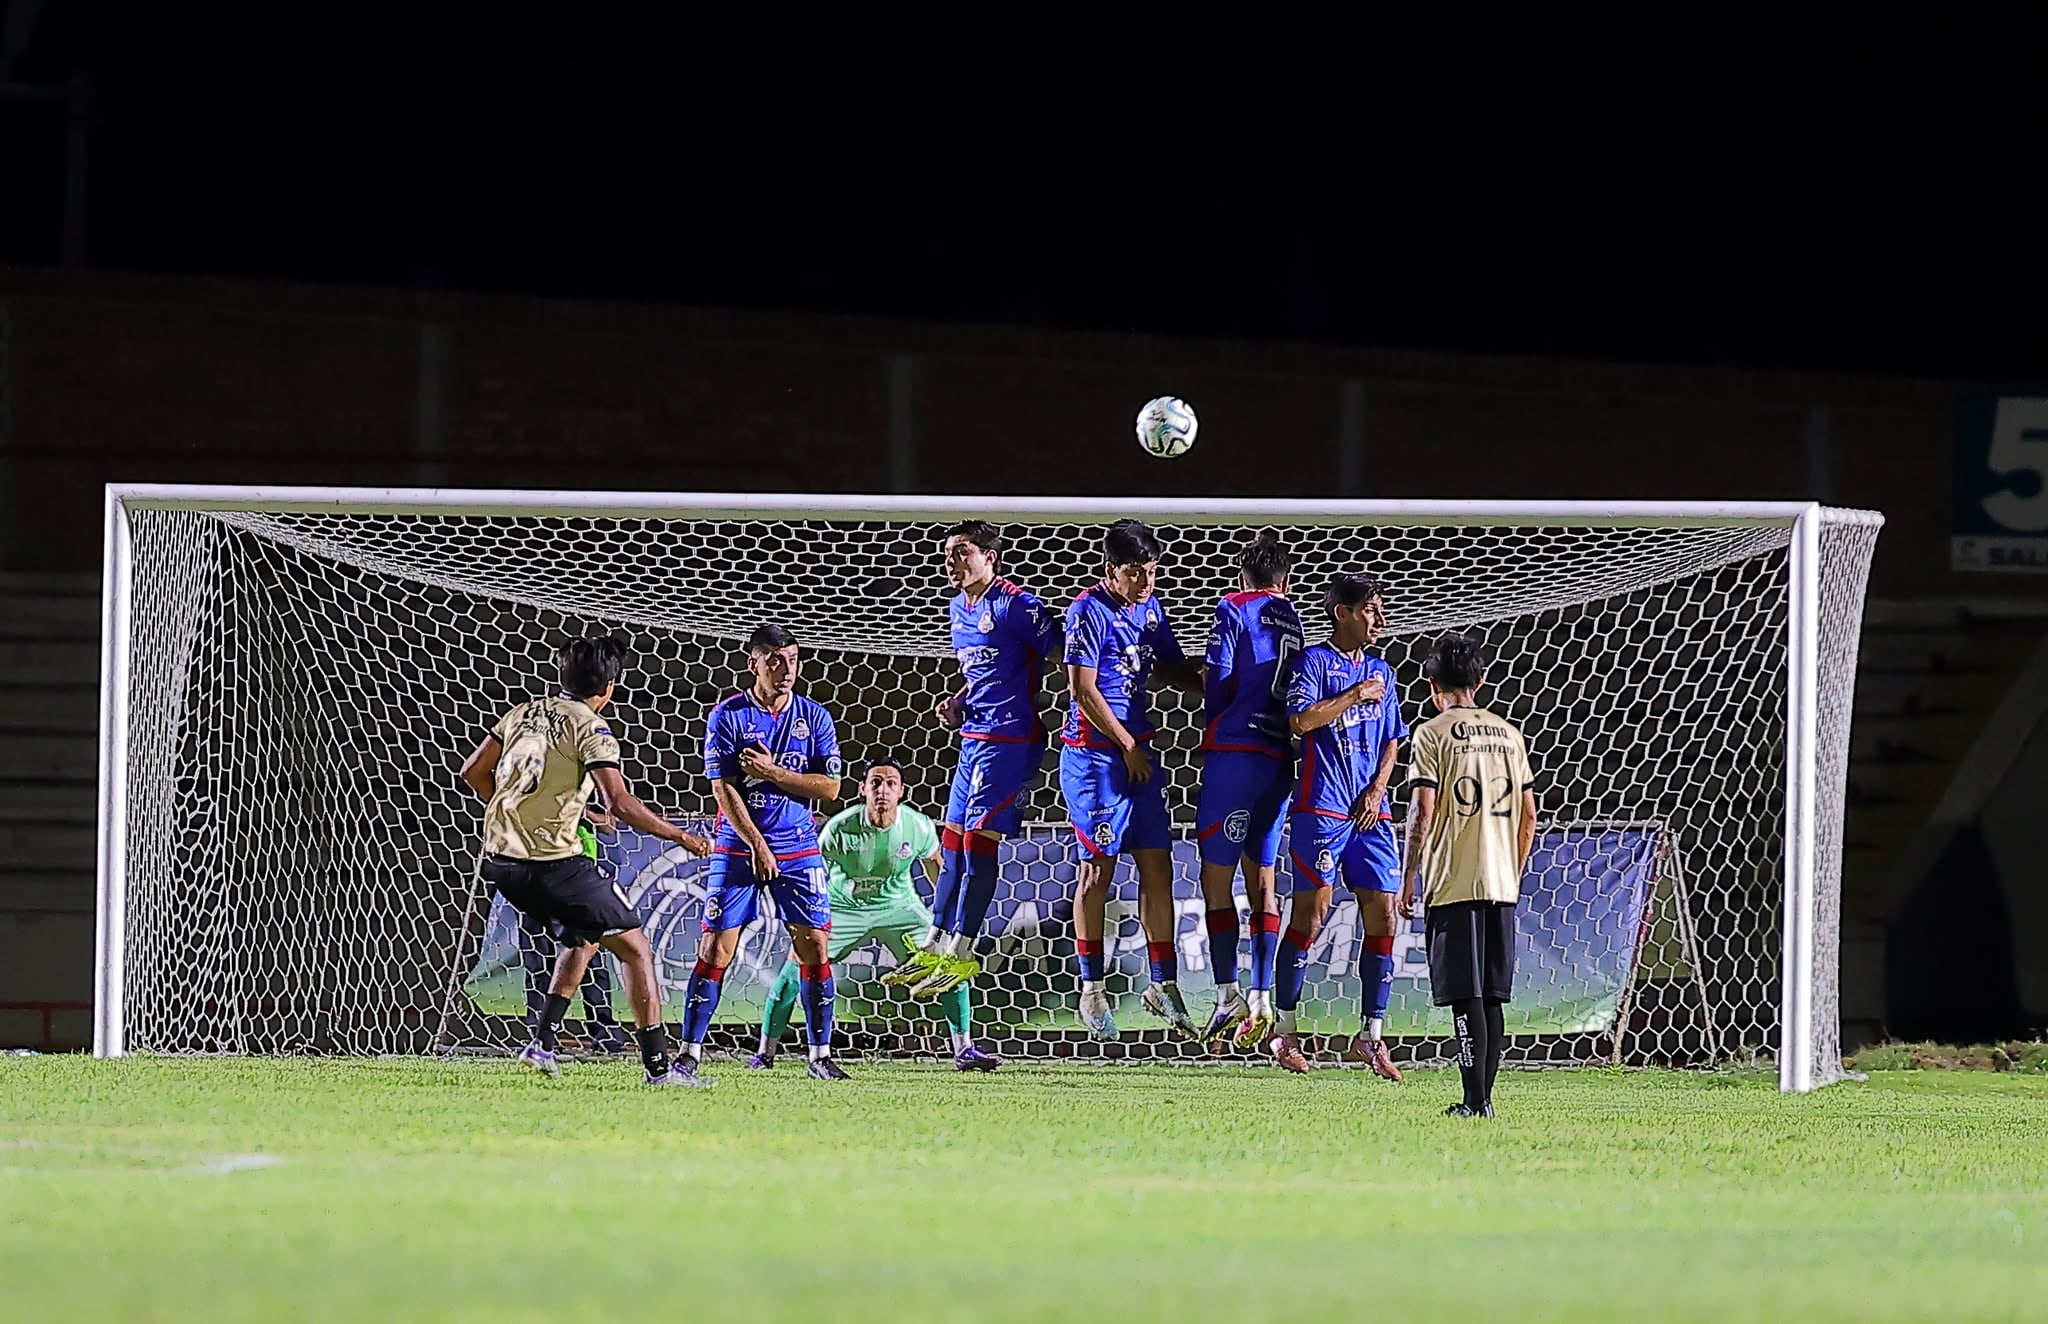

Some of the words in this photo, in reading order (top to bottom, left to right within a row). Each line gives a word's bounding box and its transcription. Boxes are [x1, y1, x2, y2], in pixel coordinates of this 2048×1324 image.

[1451, 721, 1508, 741] Corona
[1453, 775, 1513, 818] 92
[802, 867, 827, 894] 10
